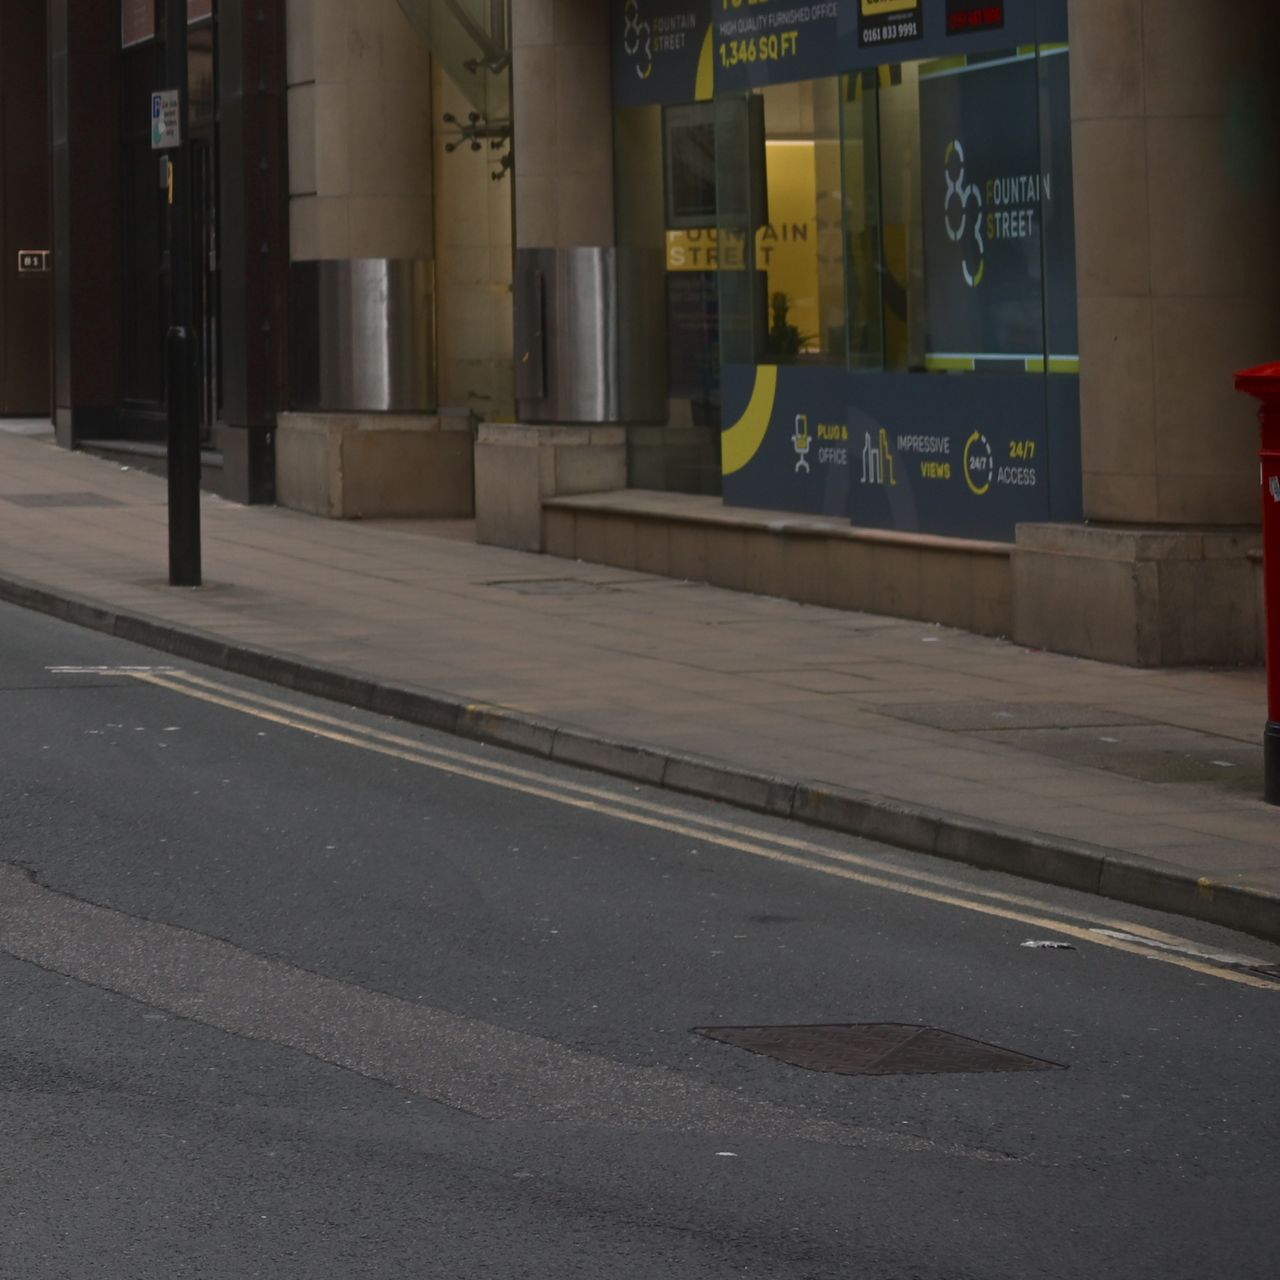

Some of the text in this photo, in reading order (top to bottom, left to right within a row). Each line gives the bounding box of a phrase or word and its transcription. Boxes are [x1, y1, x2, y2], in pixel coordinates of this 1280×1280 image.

[653, 13, 697, 33] FOUNTAIN
[719, 2, 838, 36] HIGH QUALITY FURNISHED OFFICE
[653, 33, 686, 52] STREET
[863, 28, 881, 43] 0161
[719, 31, 799, 68] 1,346 SQ FT
[986, 172, 1051, 206] FOUNTAIN
[986, 209, 1034, 240] STREET
[670, 246, 775, 266] STRET
[817, 423, 840, 440] PLUG
[896, 434, 951, 455] IMPRESSIVE
[1009, 440, 1036, 460] 24/7
[818, 447, 848, 465] OFFICE
[920, 461, 951, 480] VIEWS
[997, 466, 1037, 486] ACCESS
